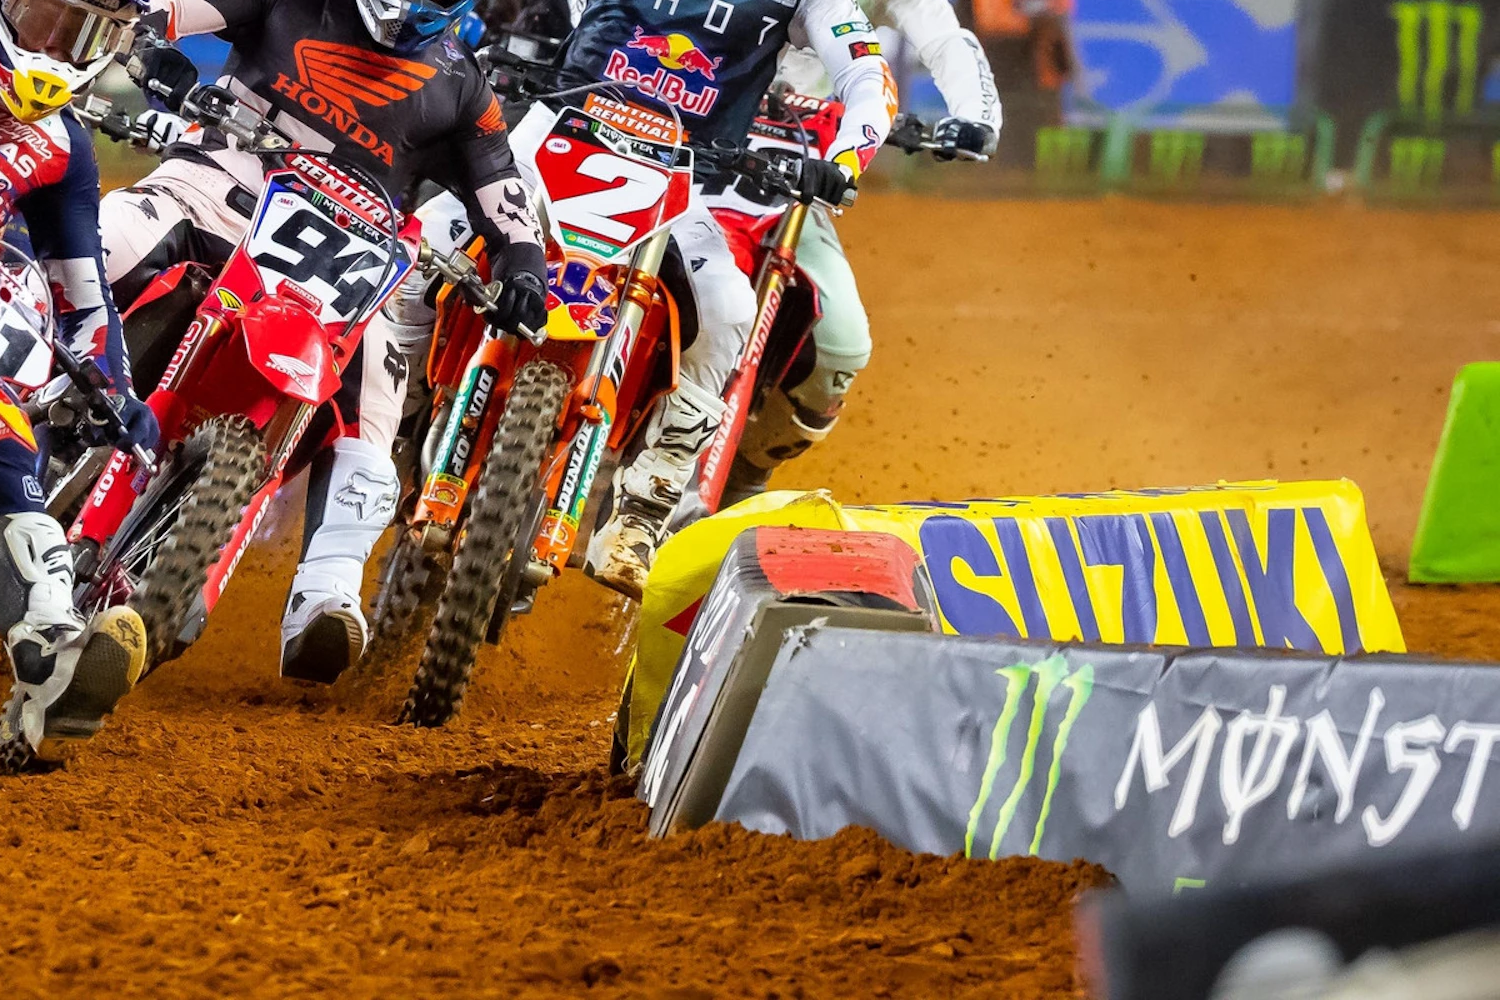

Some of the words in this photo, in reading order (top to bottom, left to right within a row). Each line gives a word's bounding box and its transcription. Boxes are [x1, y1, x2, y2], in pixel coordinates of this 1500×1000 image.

[271, 71, 395, 168] HONDA
[588, 105, 672, 142] RENTHAL
[290, 154, 397, 232] RENTHAL
[549, 151, 671, 247] 2
[254, 209, 388, 318] 94
[575, 234, 615, 255] MOTOREX
[283, 279, 324, 307] HONDA
[451, 368, 494, 477] DUNOP
[702, 392, 740, 481] DUNLOP
[919, 506, 1364, 656] SUZUKI
